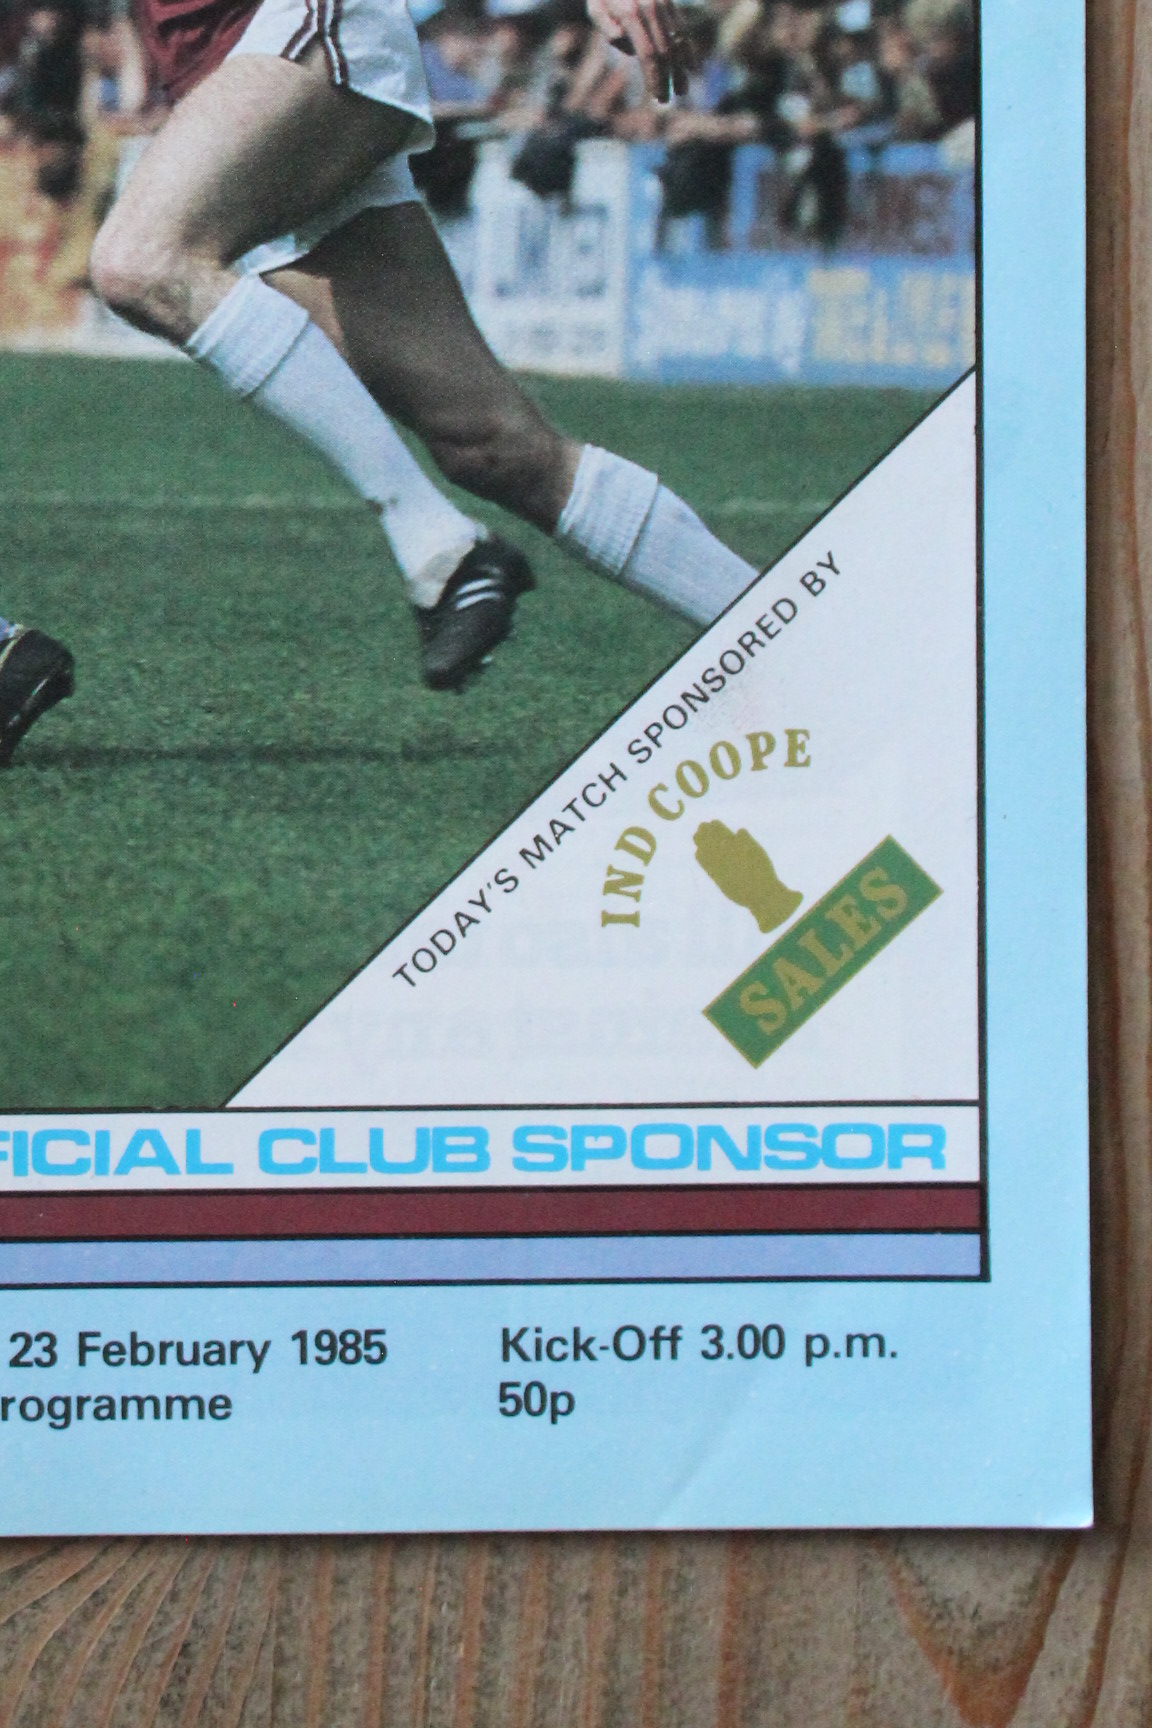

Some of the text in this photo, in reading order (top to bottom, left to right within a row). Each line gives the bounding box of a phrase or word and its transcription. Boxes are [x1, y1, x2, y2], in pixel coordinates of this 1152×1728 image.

[391, 550, 842, 989] TODAY'S MATCH SPONSORED BY
[600, 728, 812, 928] IND COOPE
[737, 867, 909, 1036] SALES
[257, 1124, 490, 1176] CLUB
[512, 1121, 947, 1174] SPONSOR
[9, 1331, 58, 1368] 23
[78, 1331, 270, 1375] February
[291, 1328, 387, 1366] 1985
[501, 1324, 899, 1367] Kick-Off 3.00 p.m.
[499, 1381, 576, 1425] 50p
